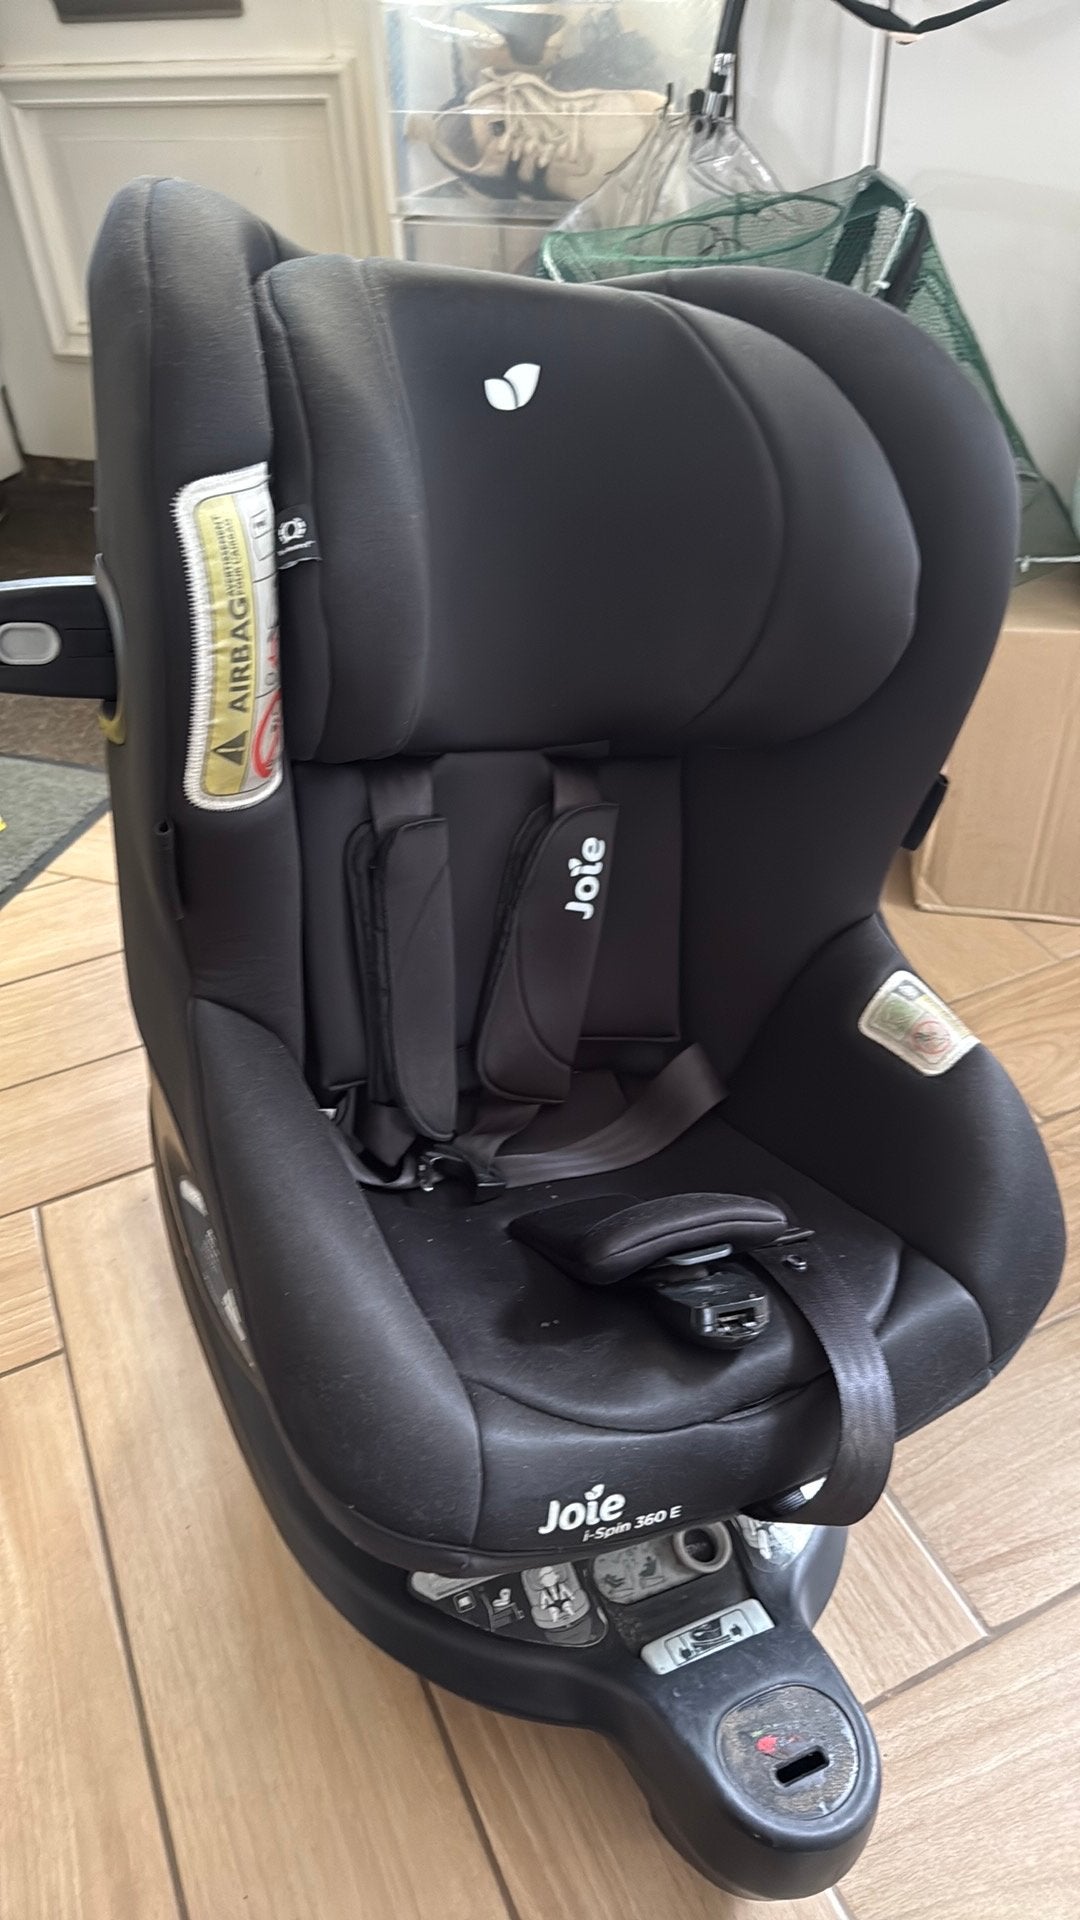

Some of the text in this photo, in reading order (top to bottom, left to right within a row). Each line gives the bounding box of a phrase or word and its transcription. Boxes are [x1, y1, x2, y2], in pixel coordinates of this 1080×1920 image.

[228, 597, 252, 713] AIRBAG
[564, 837, 606, 920] Joie
[538, 1484, 626, 1535] Joie
[582, 1505, 683, 1542] i-Spin 360 E
